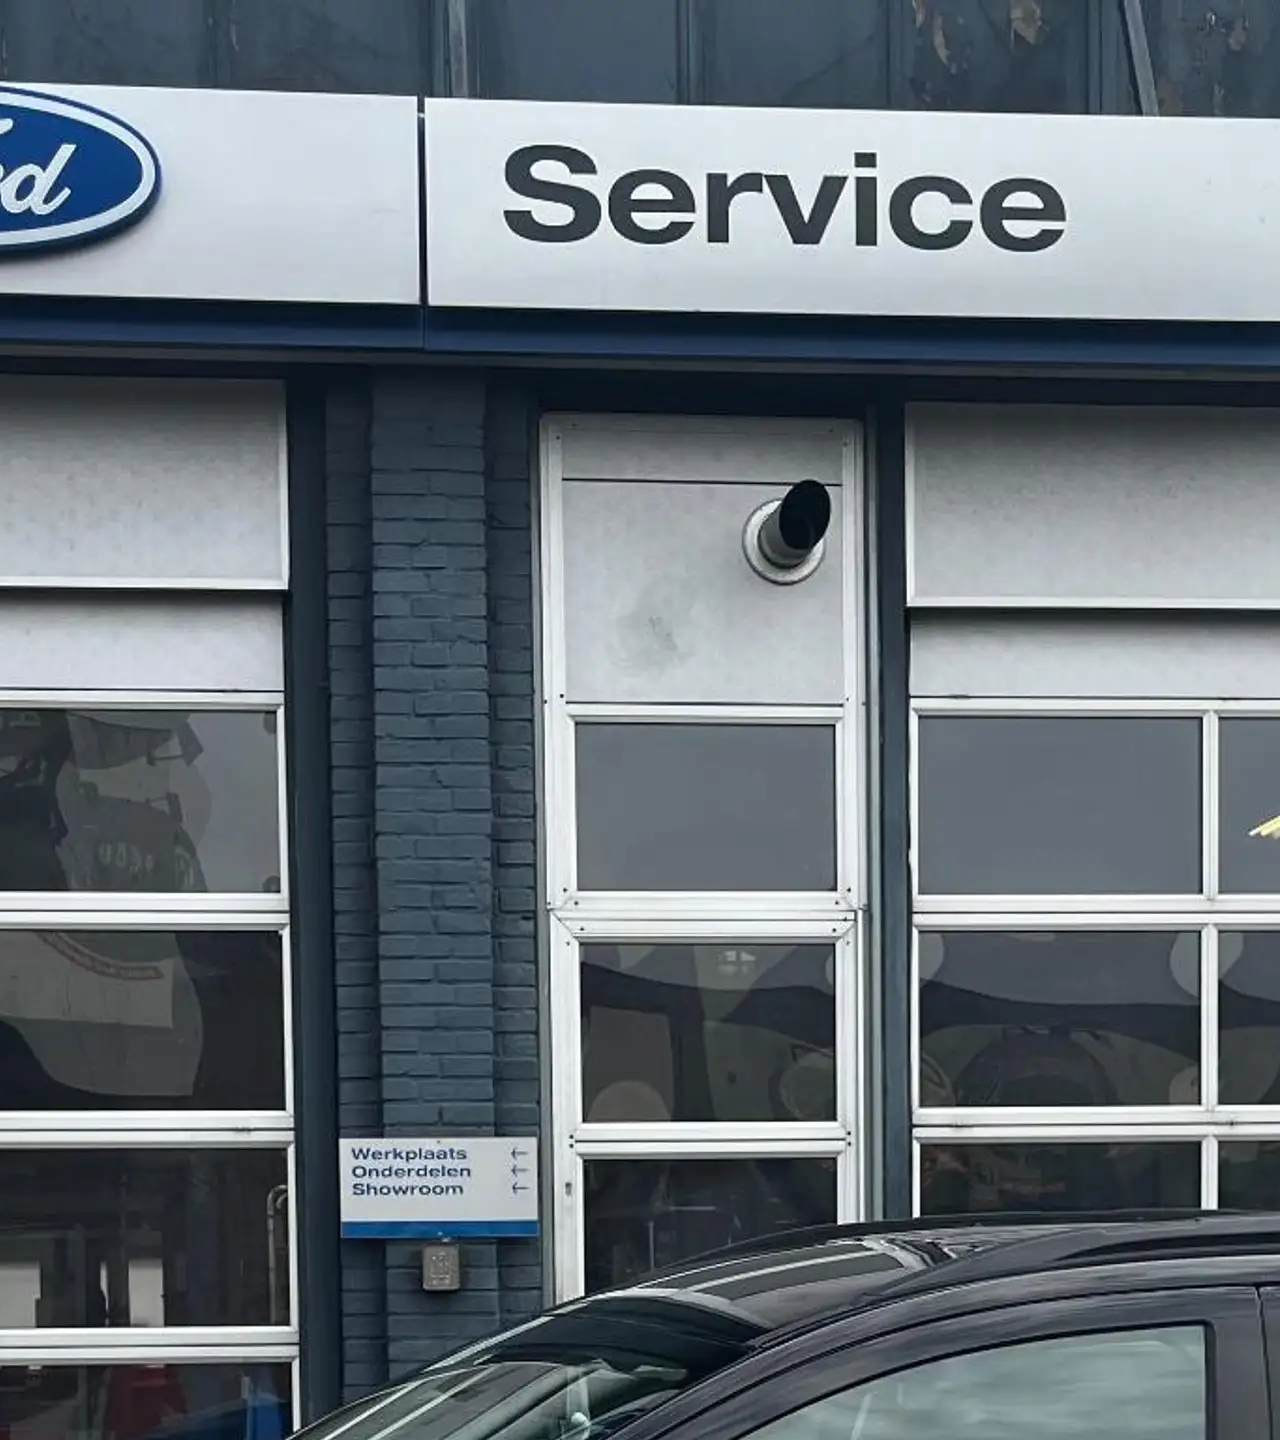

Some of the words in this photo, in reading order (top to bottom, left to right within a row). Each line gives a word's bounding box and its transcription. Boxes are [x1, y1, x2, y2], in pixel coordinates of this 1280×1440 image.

[504, 144, 1067, 253] Service
[351, 1147, 468, 1163] Werkplaats
[351, 1164, 472, 1179] Onderdelen
[352, 1182, 464, 1197] Showroom
